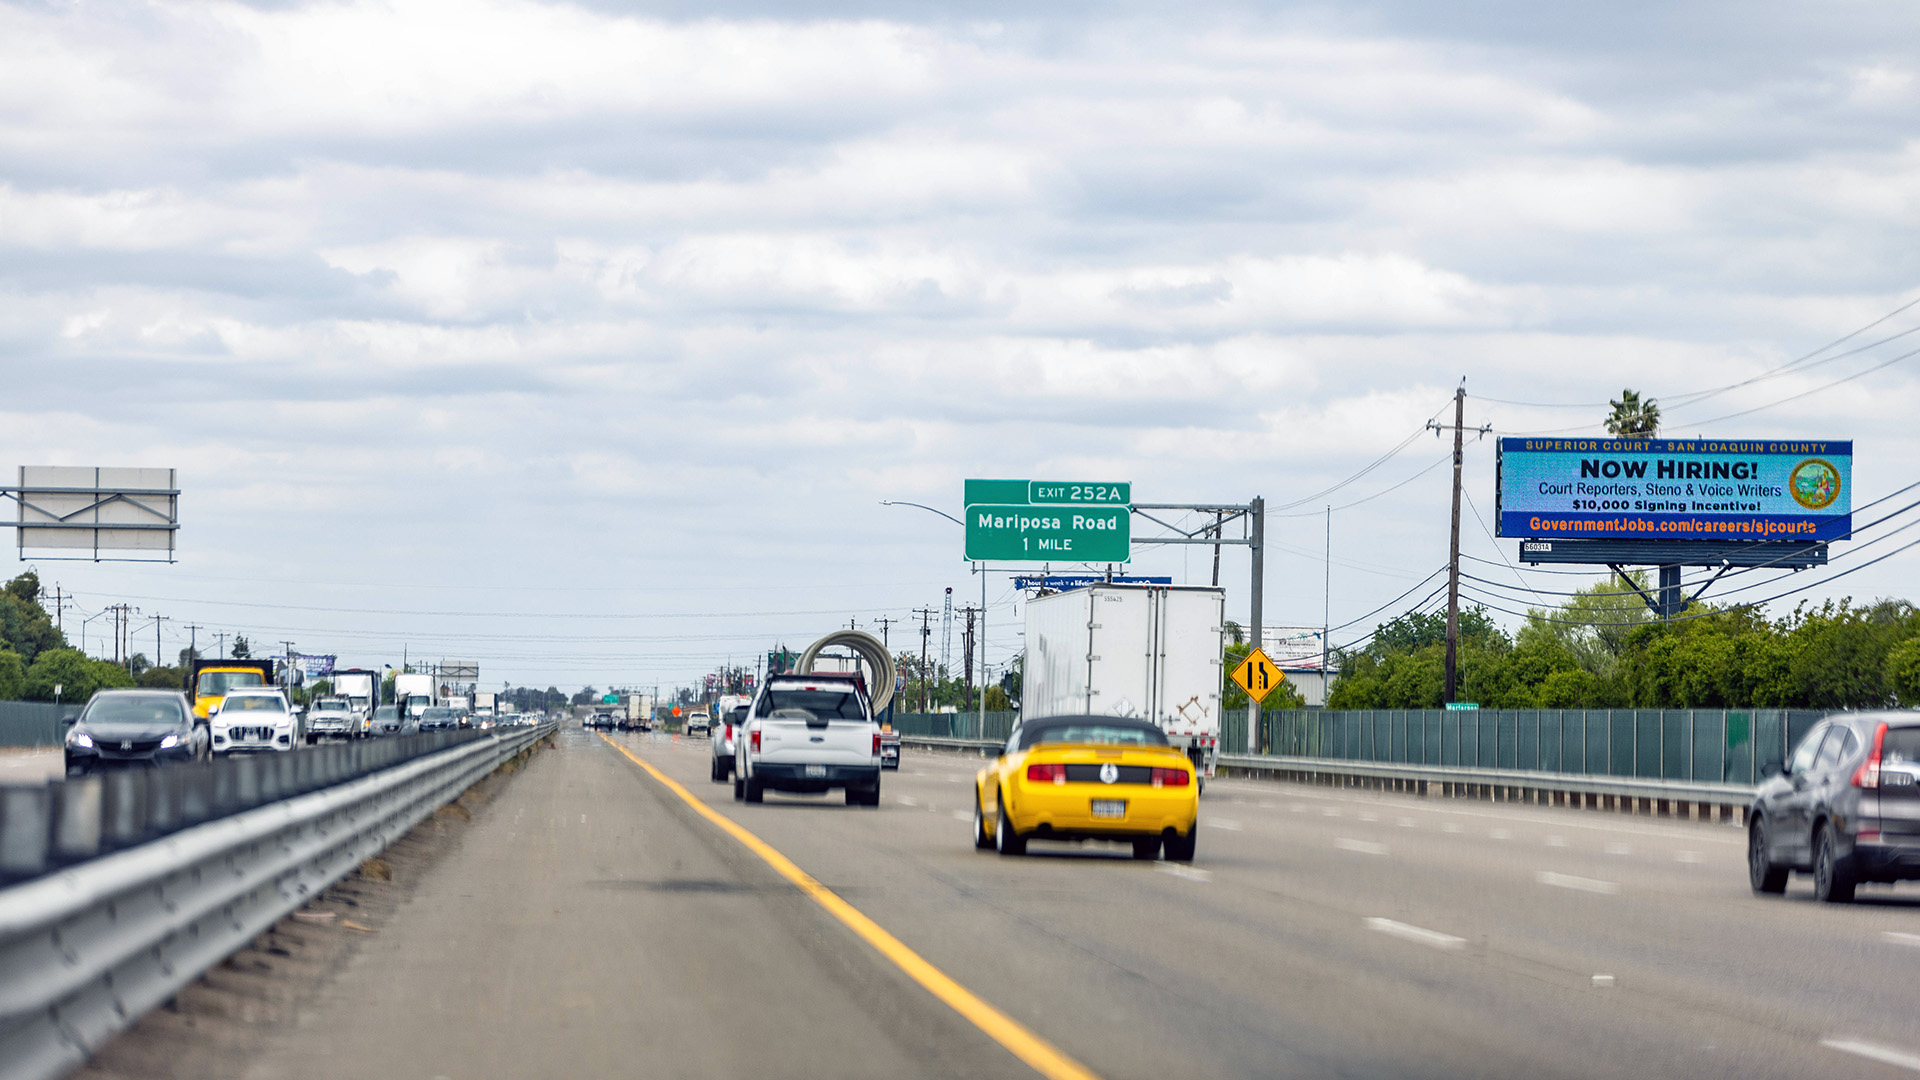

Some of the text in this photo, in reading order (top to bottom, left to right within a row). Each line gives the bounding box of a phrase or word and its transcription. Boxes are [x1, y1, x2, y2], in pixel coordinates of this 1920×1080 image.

[1526, 440, 1598, 451] SUPERIOR
[1603, 441, 1651, 451] COURT
[1667, 442, 1696, 452] SAN
[1700, 442, 1764, 453] JOAQUIN
[1769, 443, 1827, 453] COUNTY
[1581, 459, 1759, 480] NOW HIRING!
[1038, 486, 1122, 501] EXIT 252A
[1538, 481, 1783, 498] Court Reporters, Steno & Voice Writers
[1572, 499, 1761, 513] $10,000 Signing Incentive!
[978, 513, 1117, 533] Mariposa Road
[1530, 516, 1817, 537] GovernmentJobs.com/careers/sjcourts
[1022, 537, 1073, 551] 1 MILE
